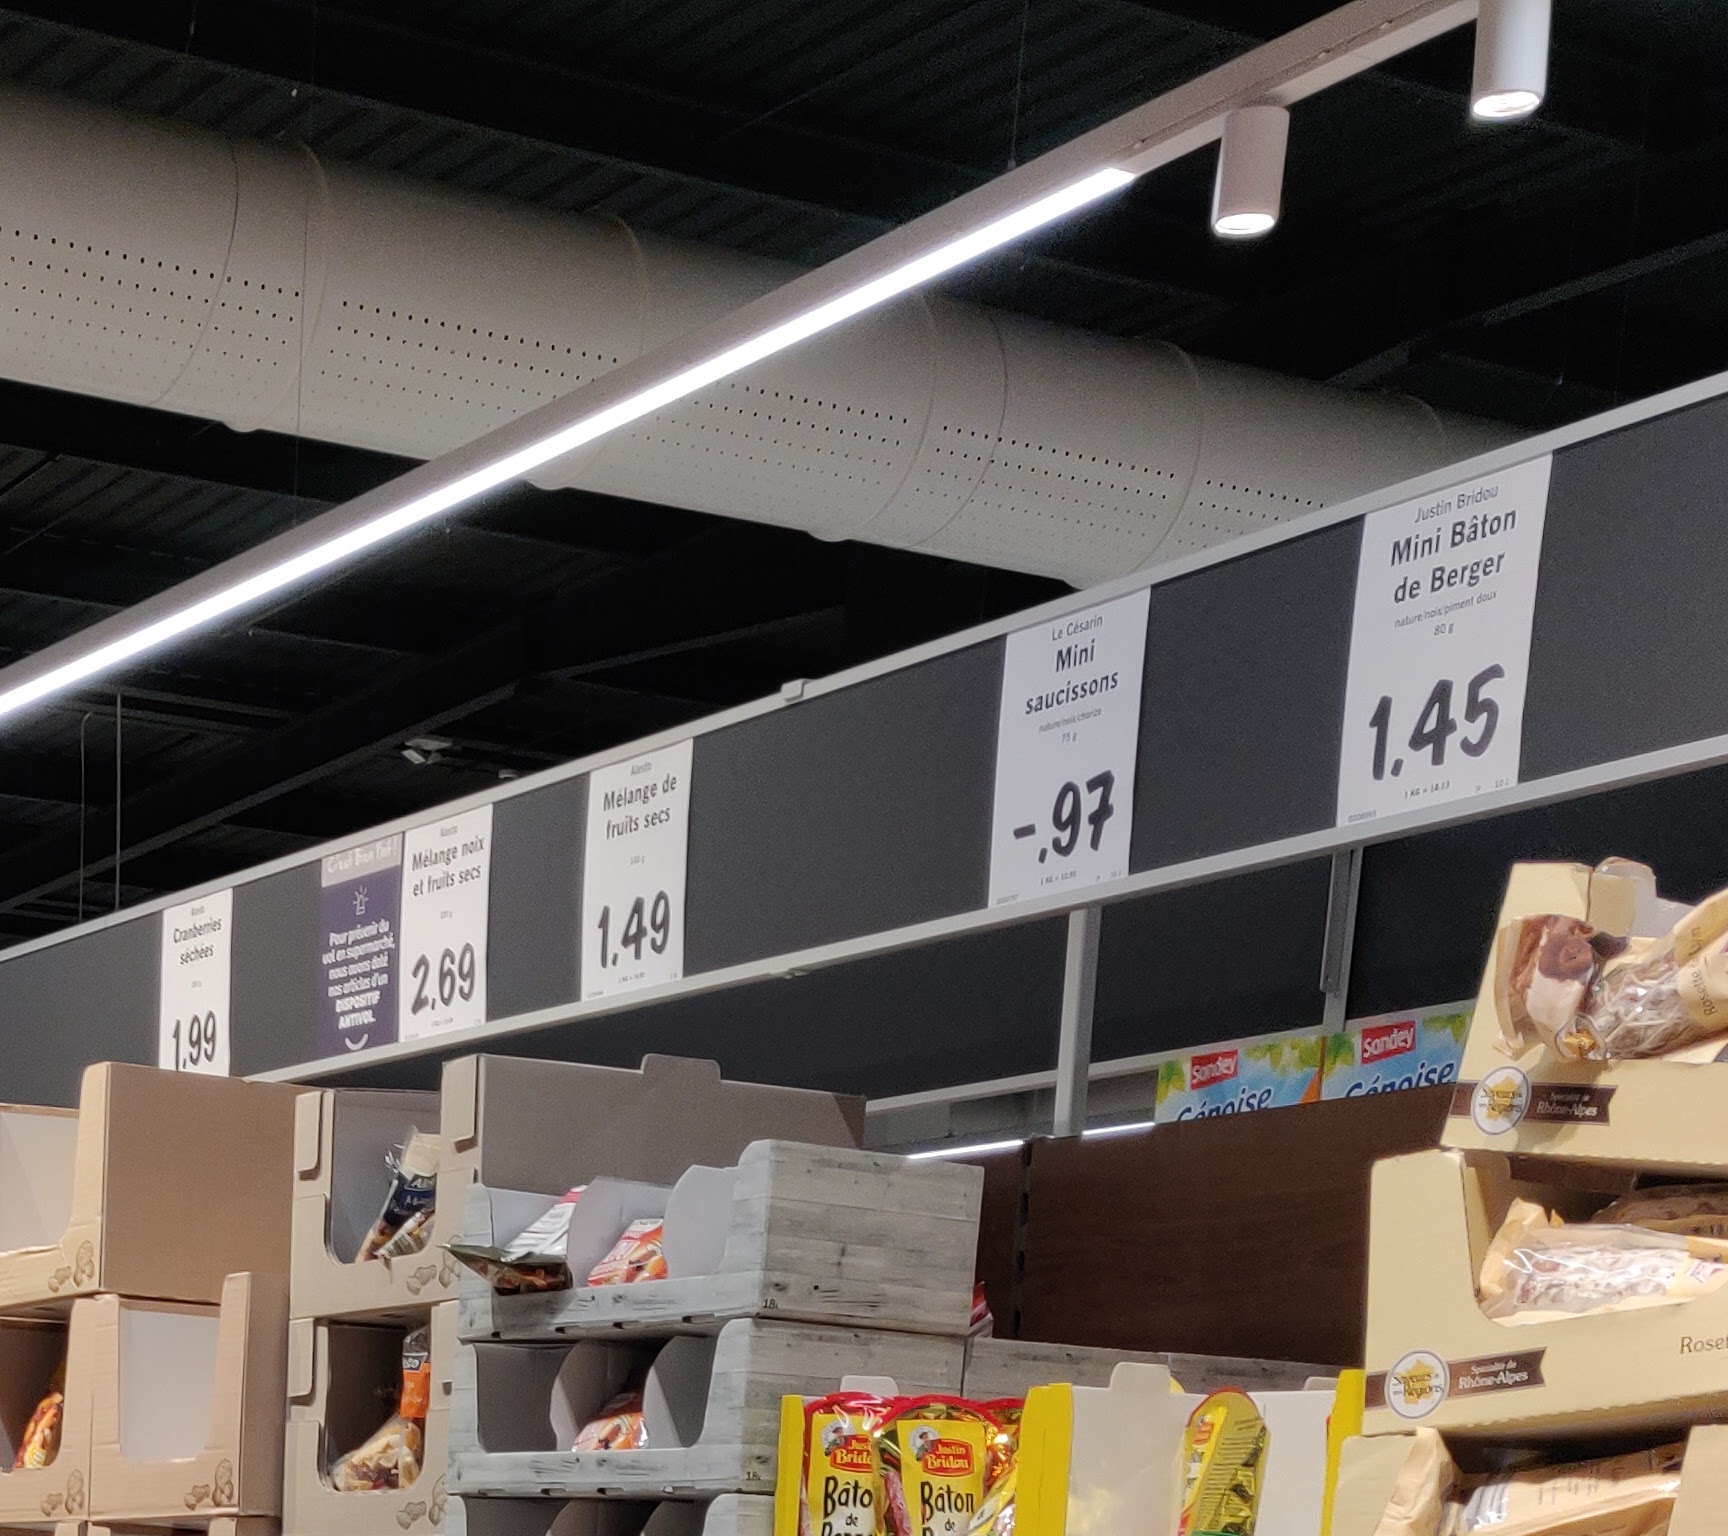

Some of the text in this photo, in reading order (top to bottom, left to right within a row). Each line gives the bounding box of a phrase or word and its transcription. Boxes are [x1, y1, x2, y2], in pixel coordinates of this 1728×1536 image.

[1415, 485, 1499, 523] Justin Bridou
[1391, 510, 1516, 567] Mini Bâton
[1394, 551, 1505, 604] de Berger
[1476, 591, 1497, 605] doux
[1052, 615, 1103, 642] Le Césarin
[1434, 624, 1446, 635] 80
[1055, 638, 1095, 672] Mini
[1025, 672, 1119, 715] saucissons
[1369, 663, 1505, 780] 1.45
[603, 773, 677, 812] Mélange de
[606, 807, 671, 840] fruits secs
[412, 845, 458, 872] Mélange
[461, 835, 485, 854] noix
[412, 864, 481, 896] et fruits secs
[598, 890, 670, 969] 1.49
[412, 942, 475, 1016] 2.69
[172, 1010, 216, 1070] 1.99
[1363, 1028, 1414, 1057] Sondey
[1192, 1057, 1236, 1081] Sondey
[1536, 1101, 1598, 1117] Rhône-Alpes
[1459, 1370, 1528, 1389] Rhône-Alpes
[926, 1454, 969, 1470] Bridou
[936, 1443, 966, 1455] Justin
[823, 1475, 873, 1518] Bâto
[920, 1481, 975, 1522] Bâton
[845, 1513, 858, 1527] de
[944, 1519, 955, 1532] de
